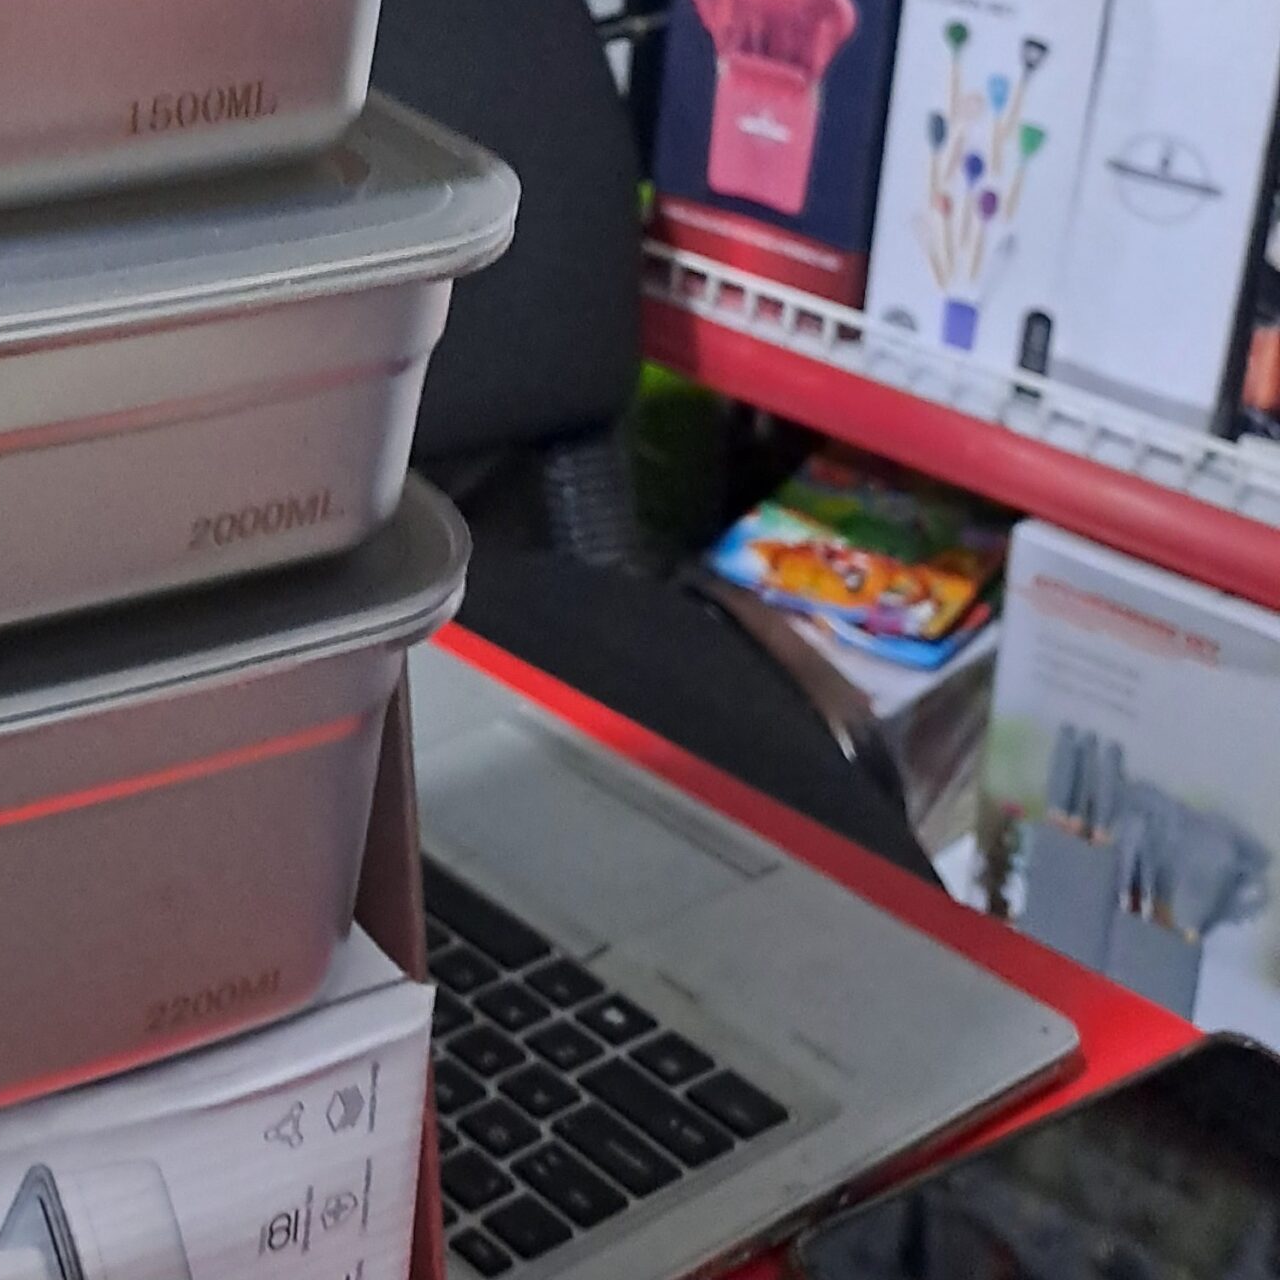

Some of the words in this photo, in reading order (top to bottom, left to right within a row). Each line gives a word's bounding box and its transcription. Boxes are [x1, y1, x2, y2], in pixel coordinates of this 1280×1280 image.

[129, 81, 277, 136] 1500ML
[186, 488, 345, 552] 2000ML
[145, 968, 288, 1032] 2200ML
